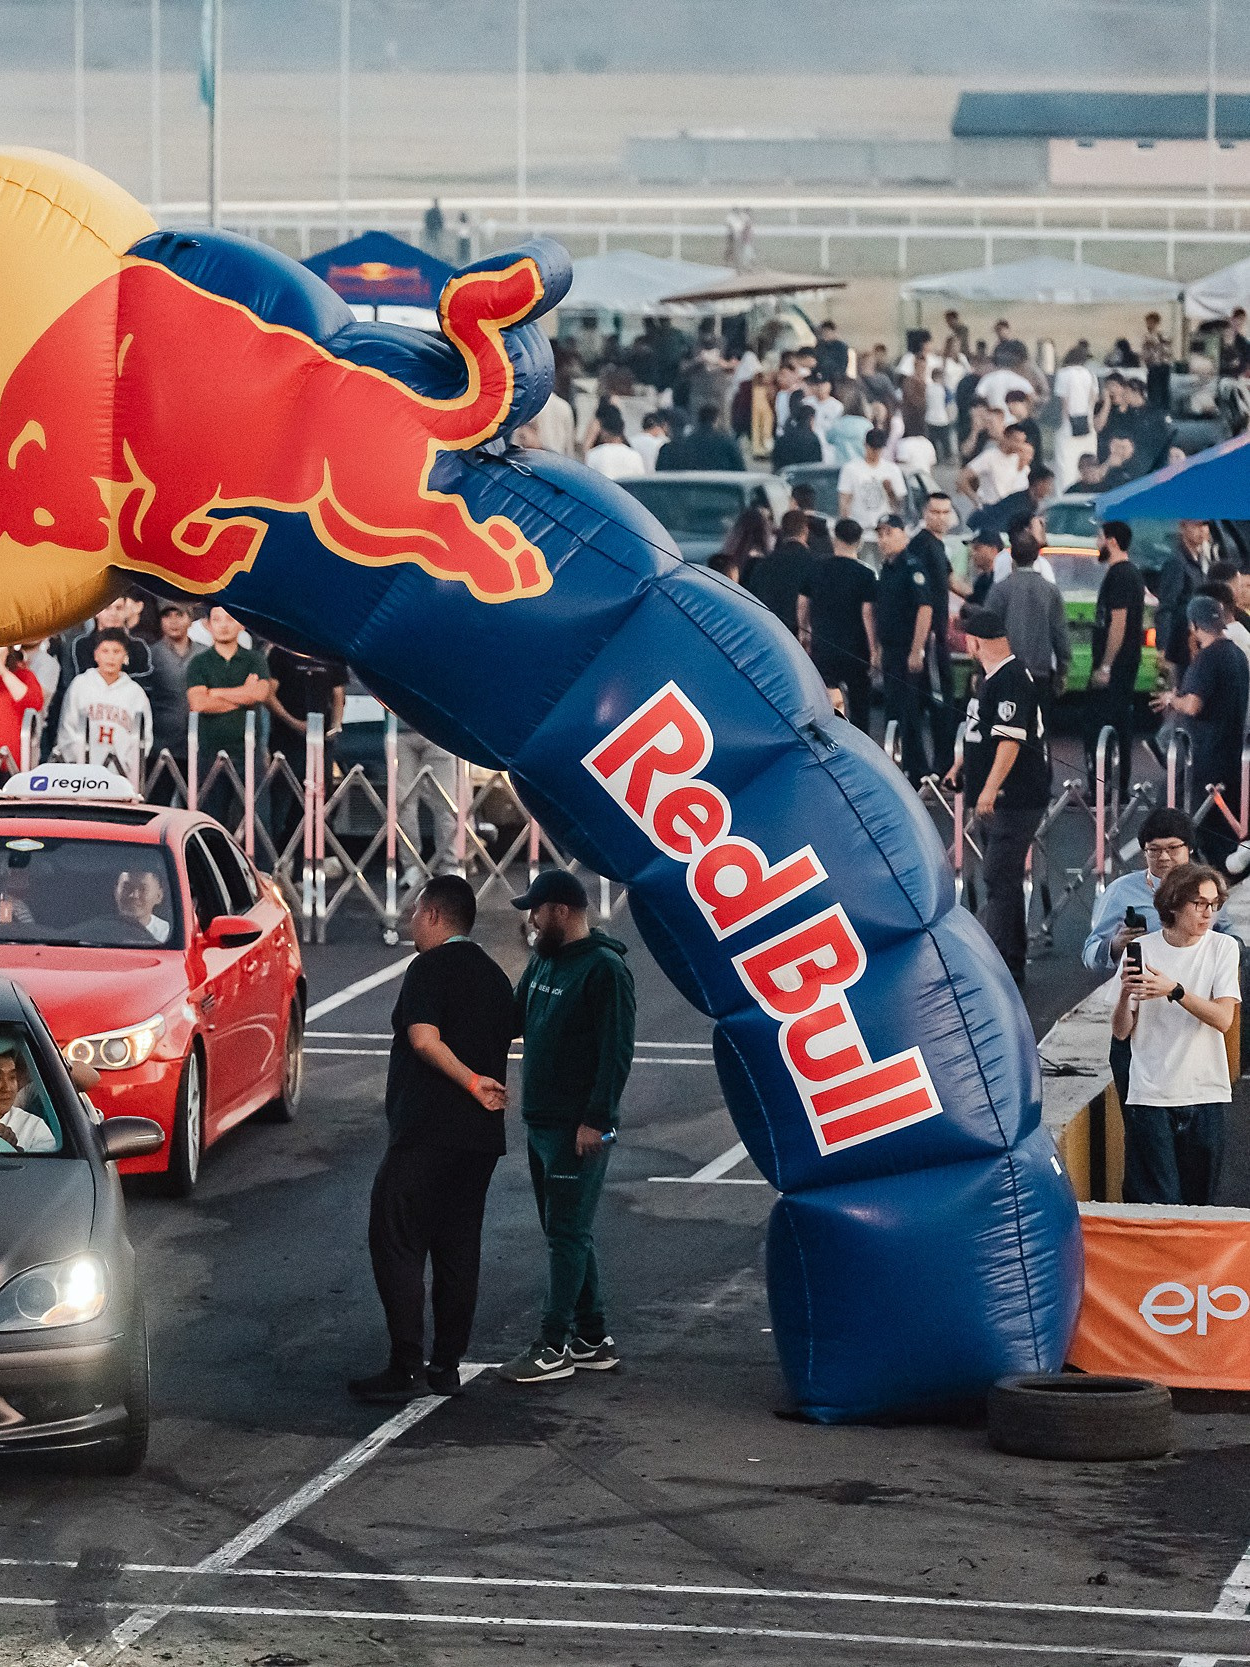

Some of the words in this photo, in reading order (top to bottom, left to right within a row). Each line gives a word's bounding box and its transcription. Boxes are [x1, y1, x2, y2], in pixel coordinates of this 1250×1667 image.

[99, 726, 113, 744] H
[52, 777, 109, 793] region
[590, 690, 819, 932] Red
[740, 912, 934, 1147] Bull
